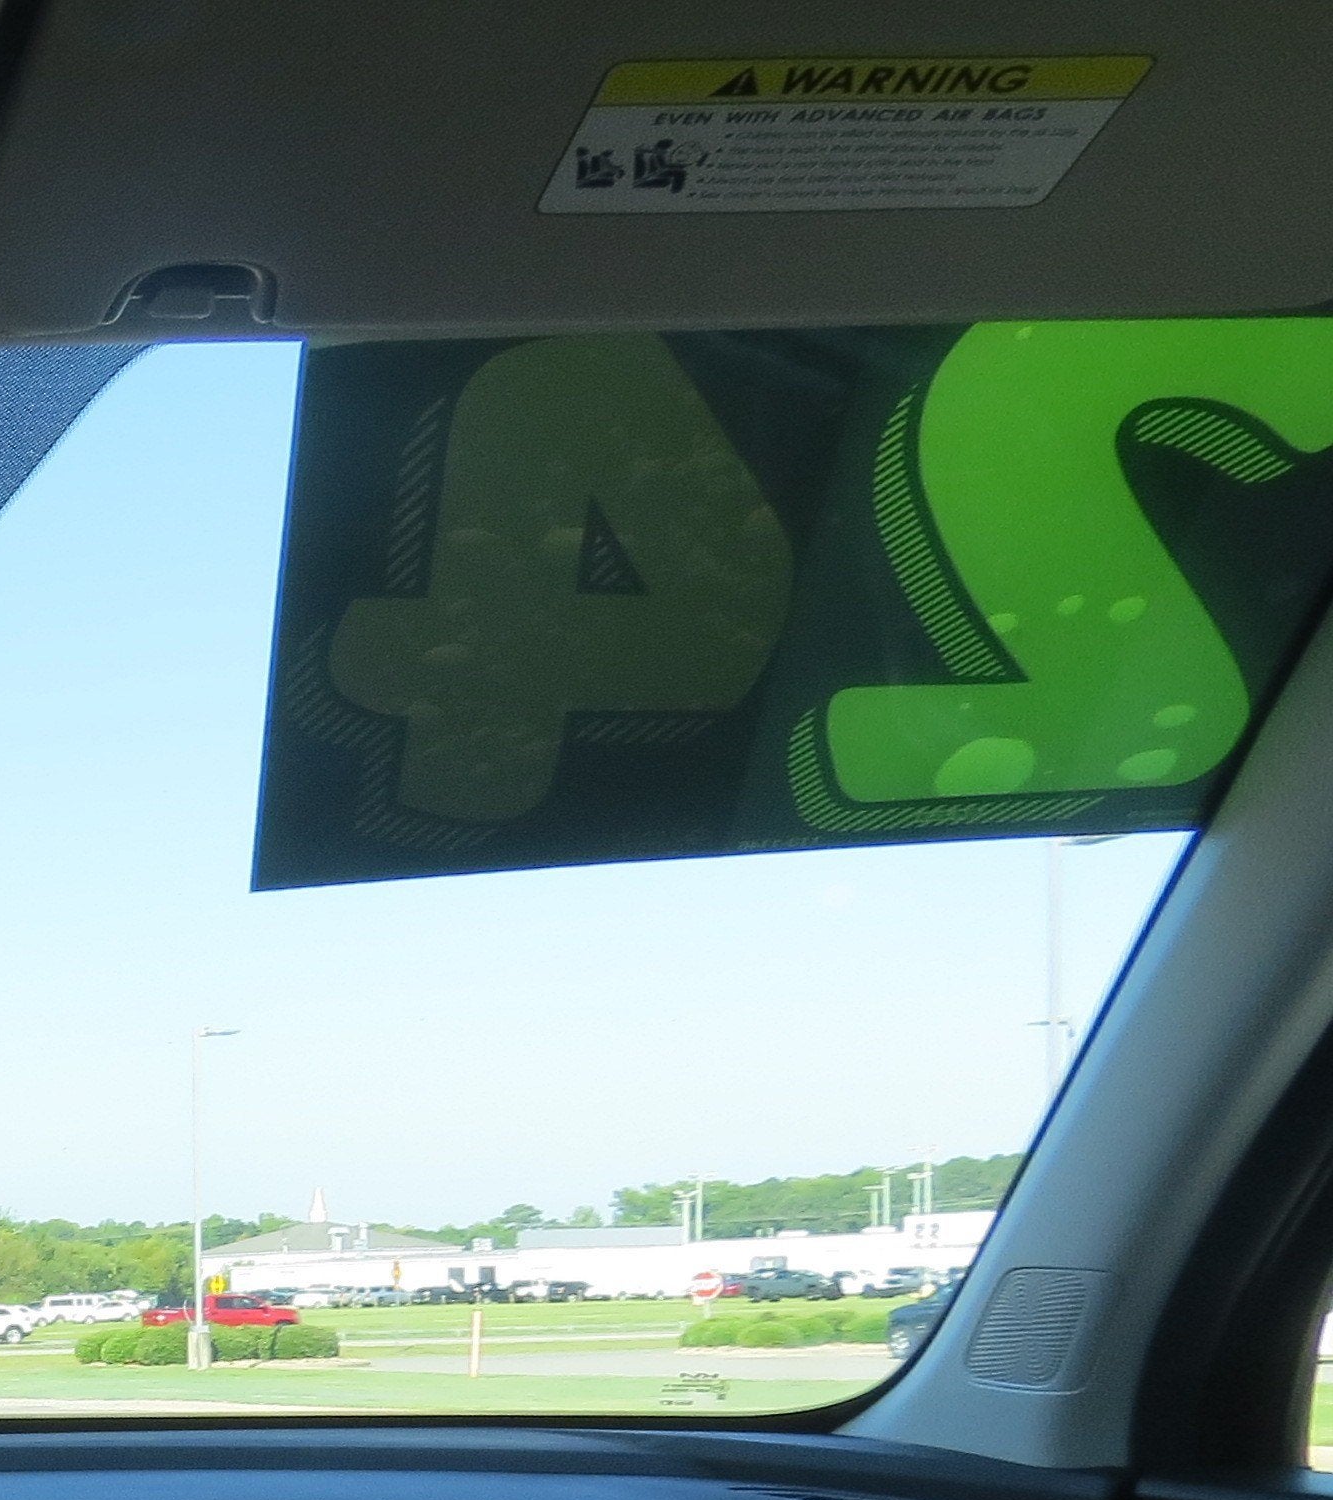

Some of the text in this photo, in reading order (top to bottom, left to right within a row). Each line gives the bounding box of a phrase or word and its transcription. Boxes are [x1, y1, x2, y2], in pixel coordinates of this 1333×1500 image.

[782, 64, 1033, 94] WARNING
[653, 107, 1047, 124] EVEN WITH ADVANCED AIR BAGS
